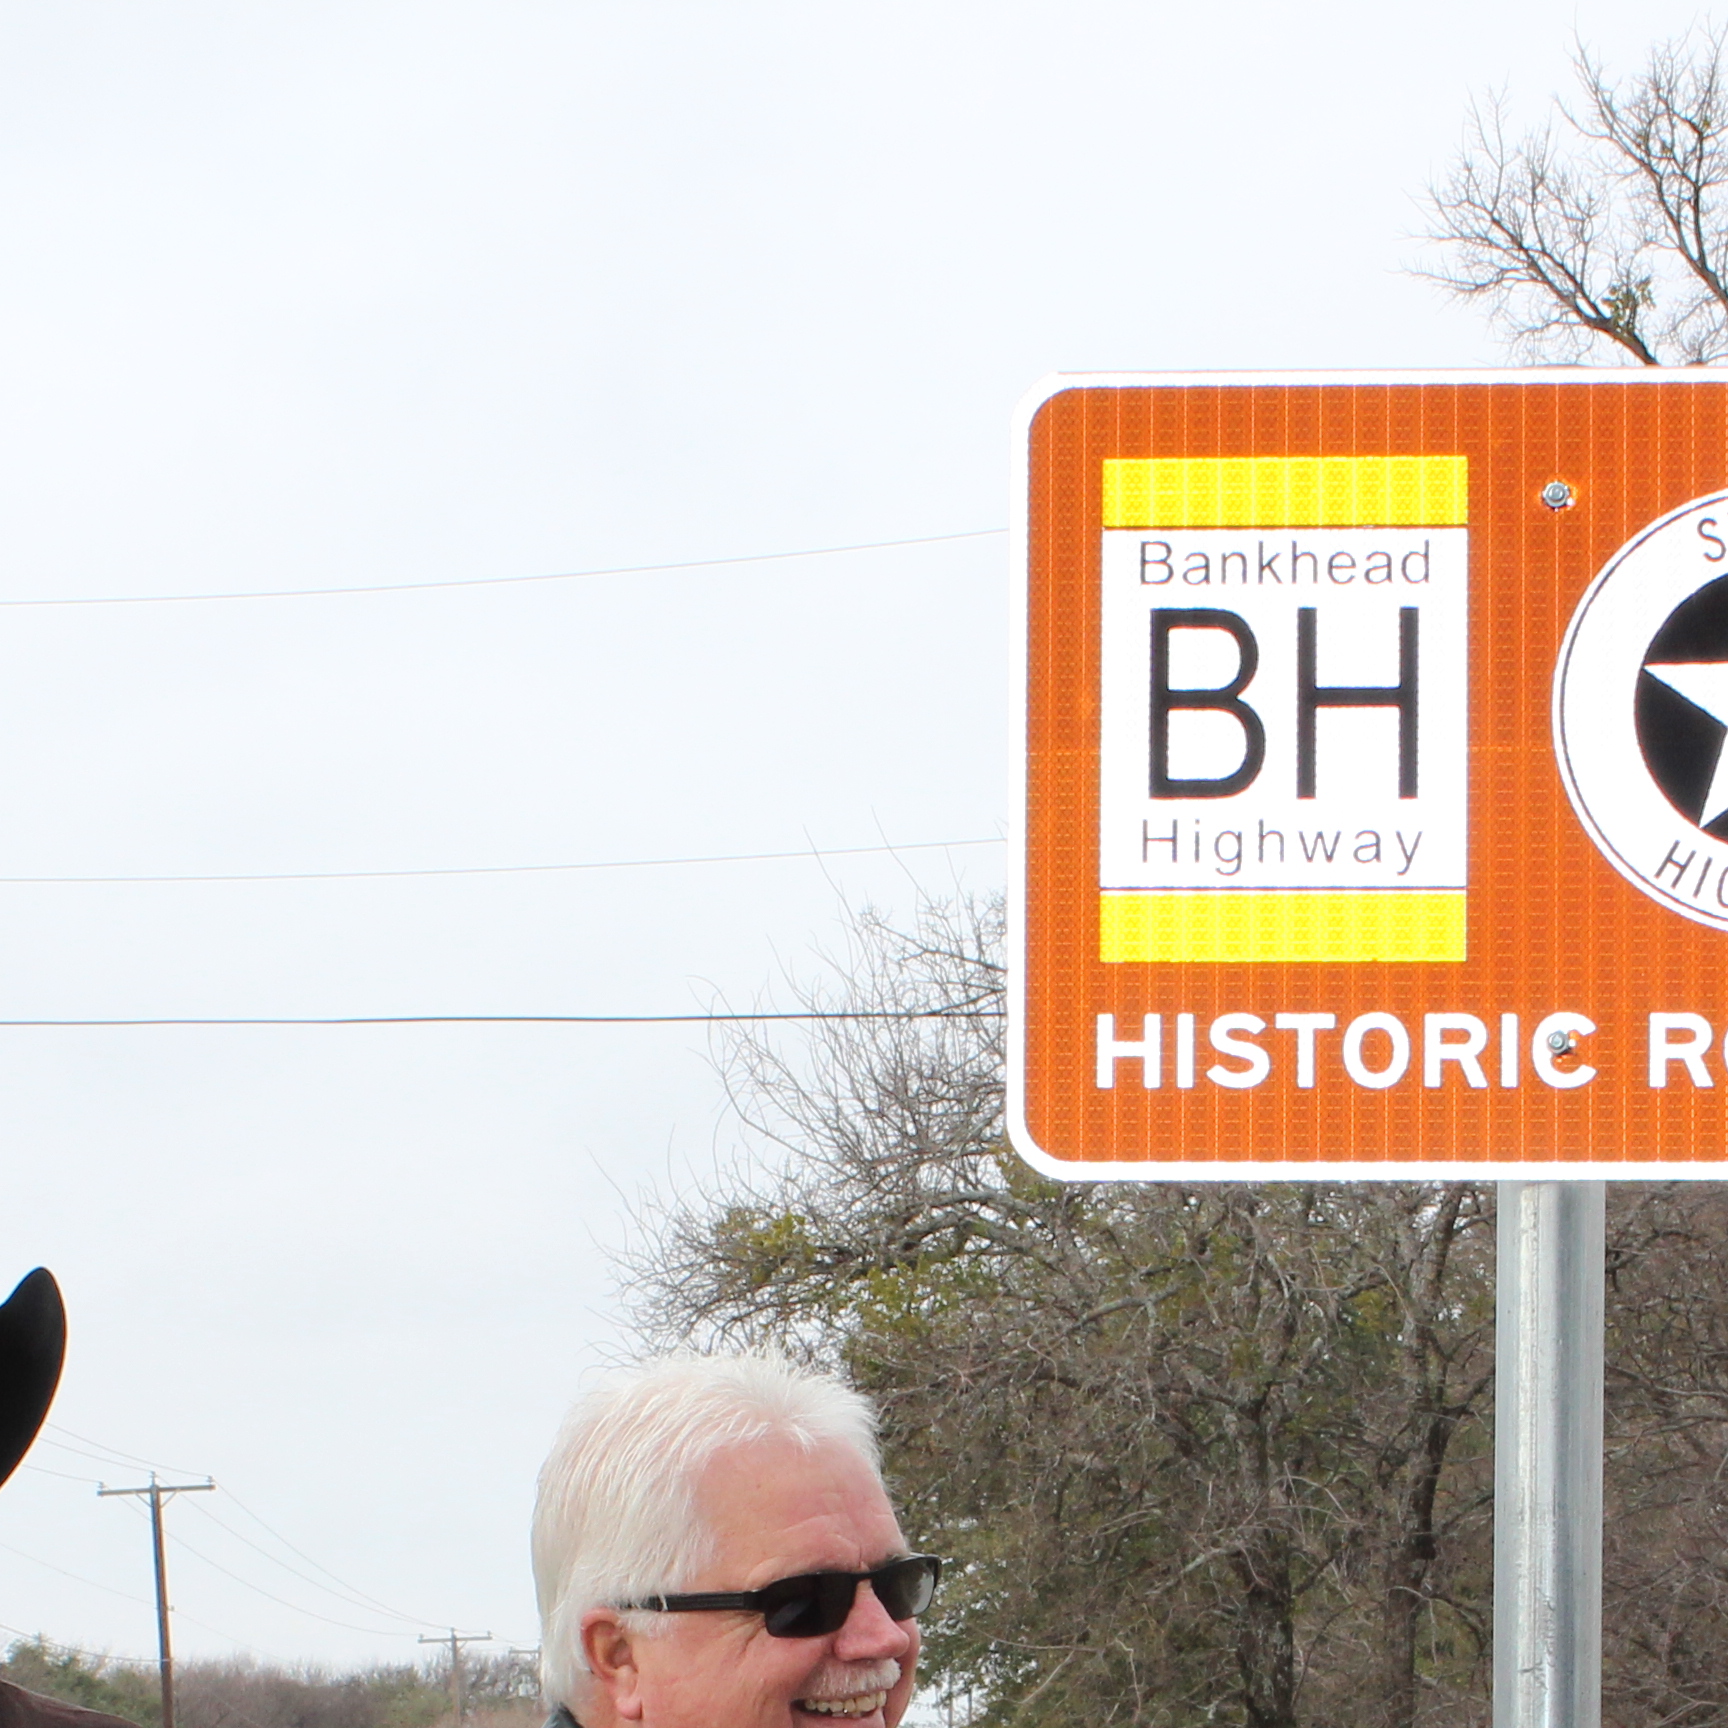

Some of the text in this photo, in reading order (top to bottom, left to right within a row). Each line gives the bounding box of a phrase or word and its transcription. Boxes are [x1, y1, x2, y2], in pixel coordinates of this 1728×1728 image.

[1138, 540, 1432, 586] Bankhead
[1148, 607, 1420, 799] BH
[1140, 818, 1424, 876] Highway
[1096, 1011, 1598, 1090] HISTORIC
